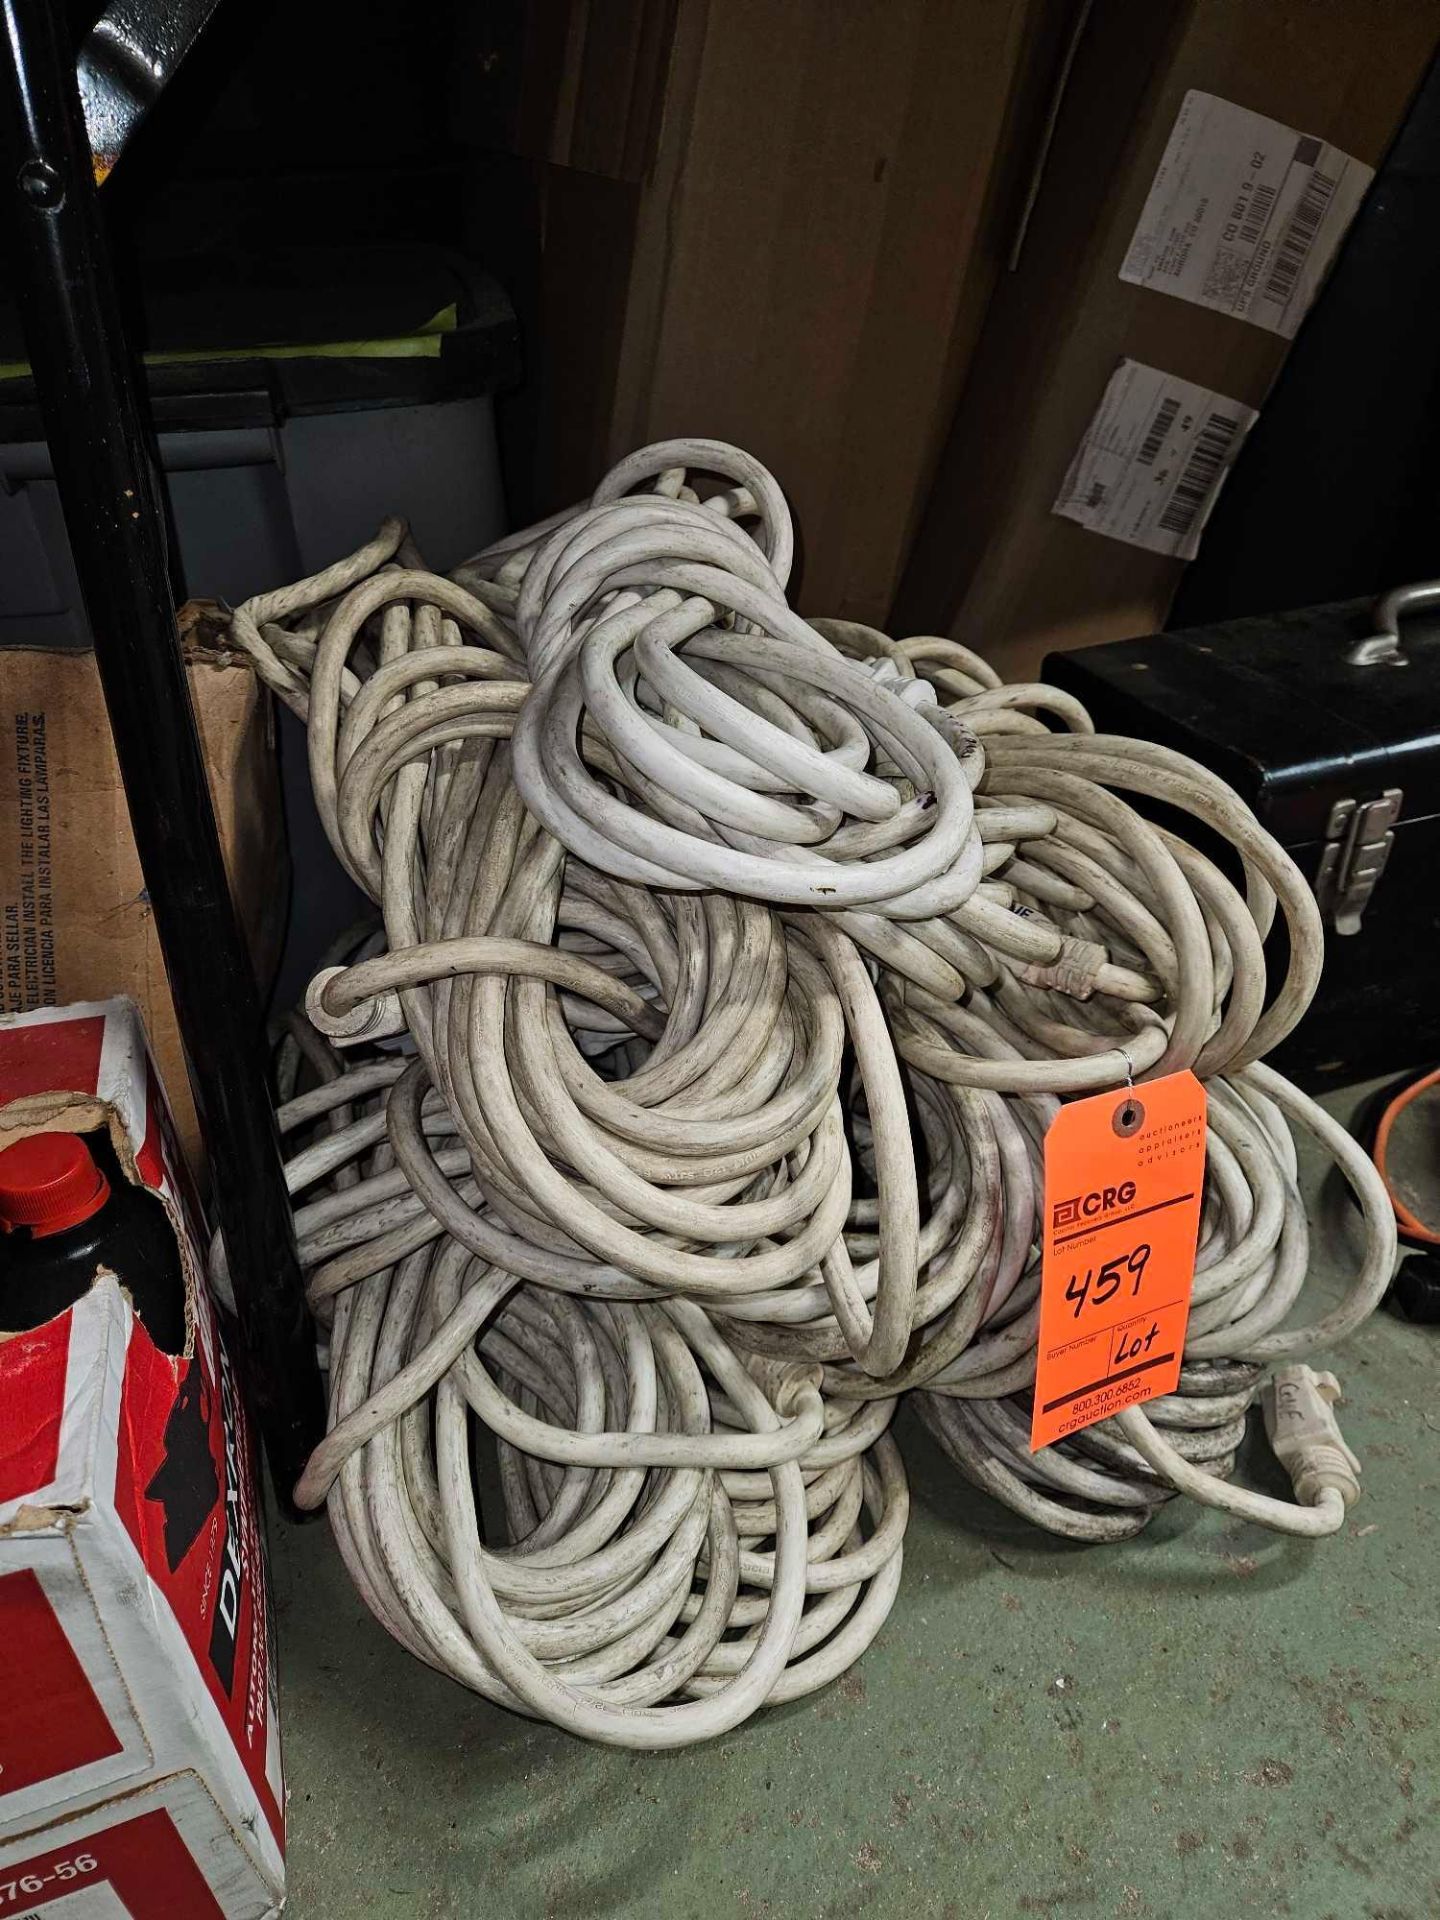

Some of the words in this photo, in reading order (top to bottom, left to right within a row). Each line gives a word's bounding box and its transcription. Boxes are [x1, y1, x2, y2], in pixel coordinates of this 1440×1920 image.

[1223, 226, 1239, 242] CO
[1247, 240, 1272, 287] GROUND
[18, 778, 33, 838] LIGHTING
[37, 796, 49, 820] LAS
[20, 842, 33, 866] THE
[38, 825, 51, 889] INSTALAR
[22, 871, 36, 922] INSTALL
[40, 893, 52, 926] PARA
[7, 902, 20, 951] SELLAR.
[9, 956, 21, 988] PARA
[24, 927, 38, 1004] ELECTRICIAN
[41, 930, 55, 985] LICENCIA
[1138, 1128, 1202, 1154] appraisers
[1139, 1115, 1202, 1141] auctioneers
[1137, 1142, 1201, 1167] advisors
[1082, 1181, 1137, 1216] CRG
[1053, 1245, 1066, 1257] Lot
[1067, 1235, 1097, 1252] Number
[1065, 1243, 1152, 1318] 459
[1116, 1316, 1148, 1333] Quantity
[1046, 1349, 1067, 1362] Buyer
[1068, 1335, 1098, 1351] Number
[1114, 1322, 1160, 1365] Lot
[1058, 1386, 1152, 1434] crgauction.com
[1072, 1377, 1142, 1416] 800.300.6852
